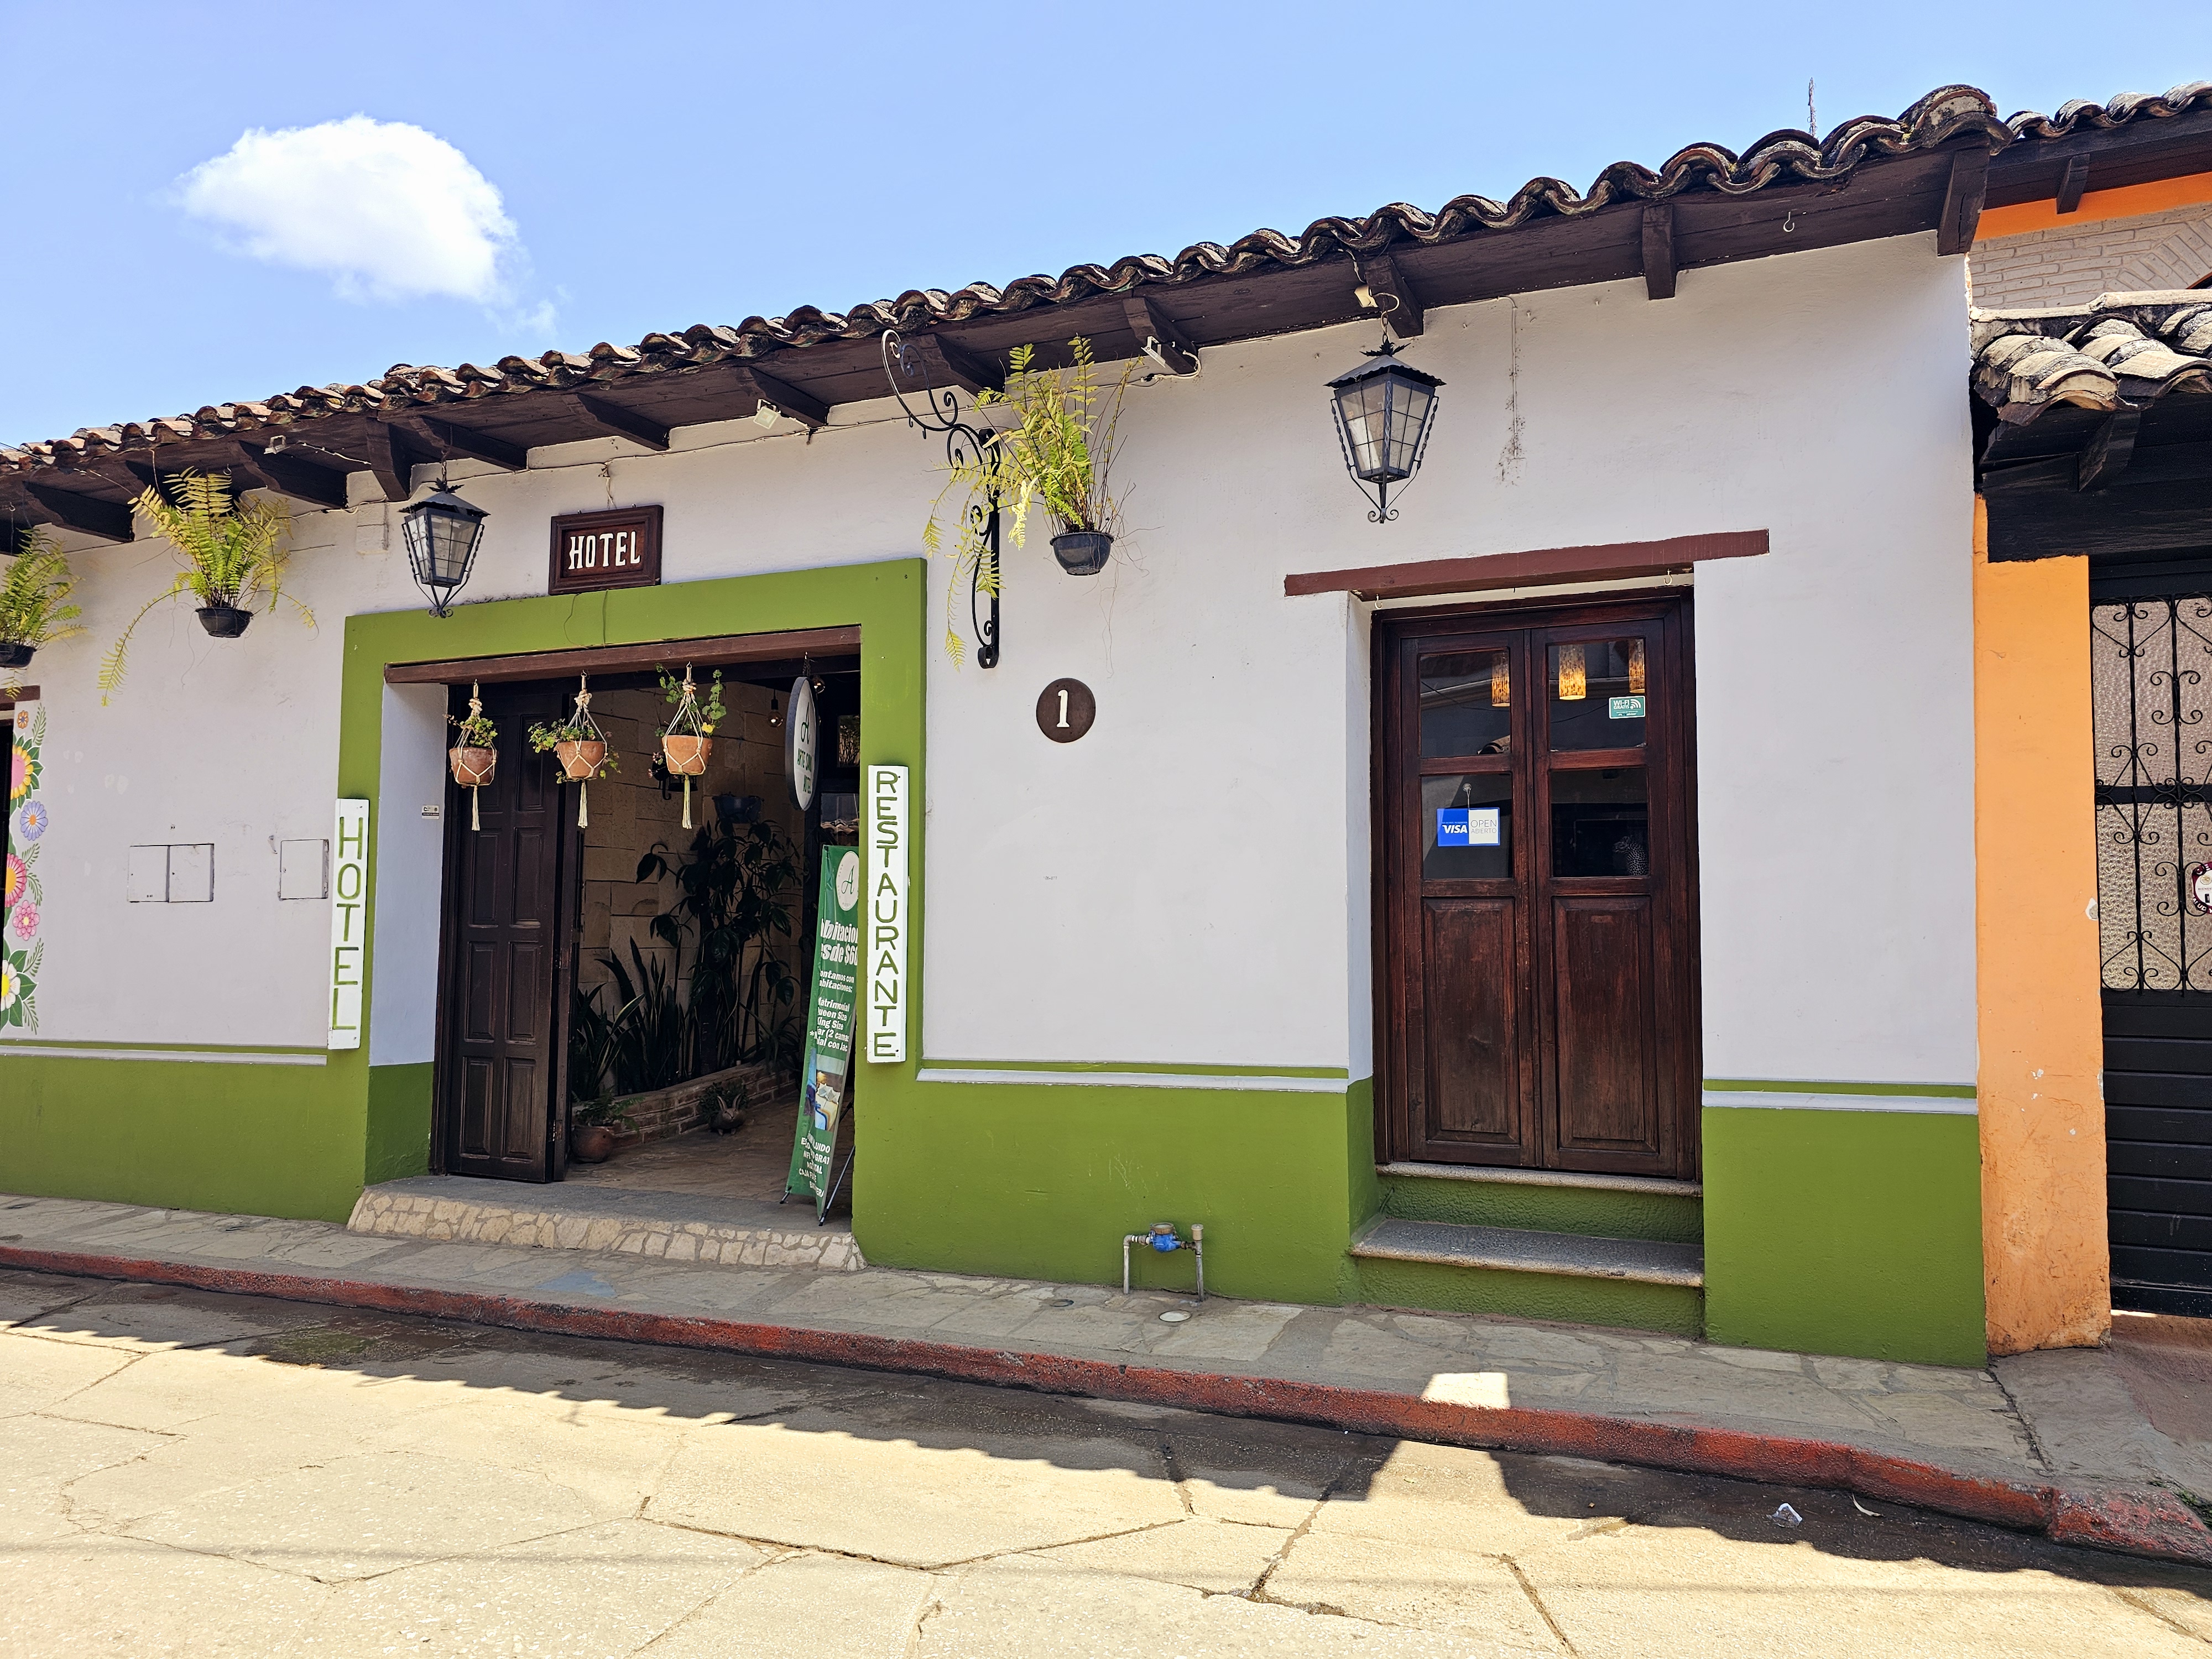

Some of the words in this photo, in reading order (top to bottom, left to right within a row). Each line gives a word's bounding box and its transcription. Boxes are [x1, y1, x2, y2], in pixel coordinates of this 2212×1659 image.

[568, 531, 640, 570] HOTEL
[1057, 690, 1070, 727] 1
[1442, 825, 1468, 833] VISA
[1470, 820, 1497, 828] OPEN
[874, 771, 899, 1057] RESTAURANTE
[332, 816, 363, 1030] HOTEL
[820, 971, 846, 982] ontamos
[846, 975, 854, 983] con
[819, 978, 853, 993] abitaciones:
[837, 1011, 847, 1021] Size
[831, 1020, 844, 1030] Size
[827, 1041, 840, 1050] con
